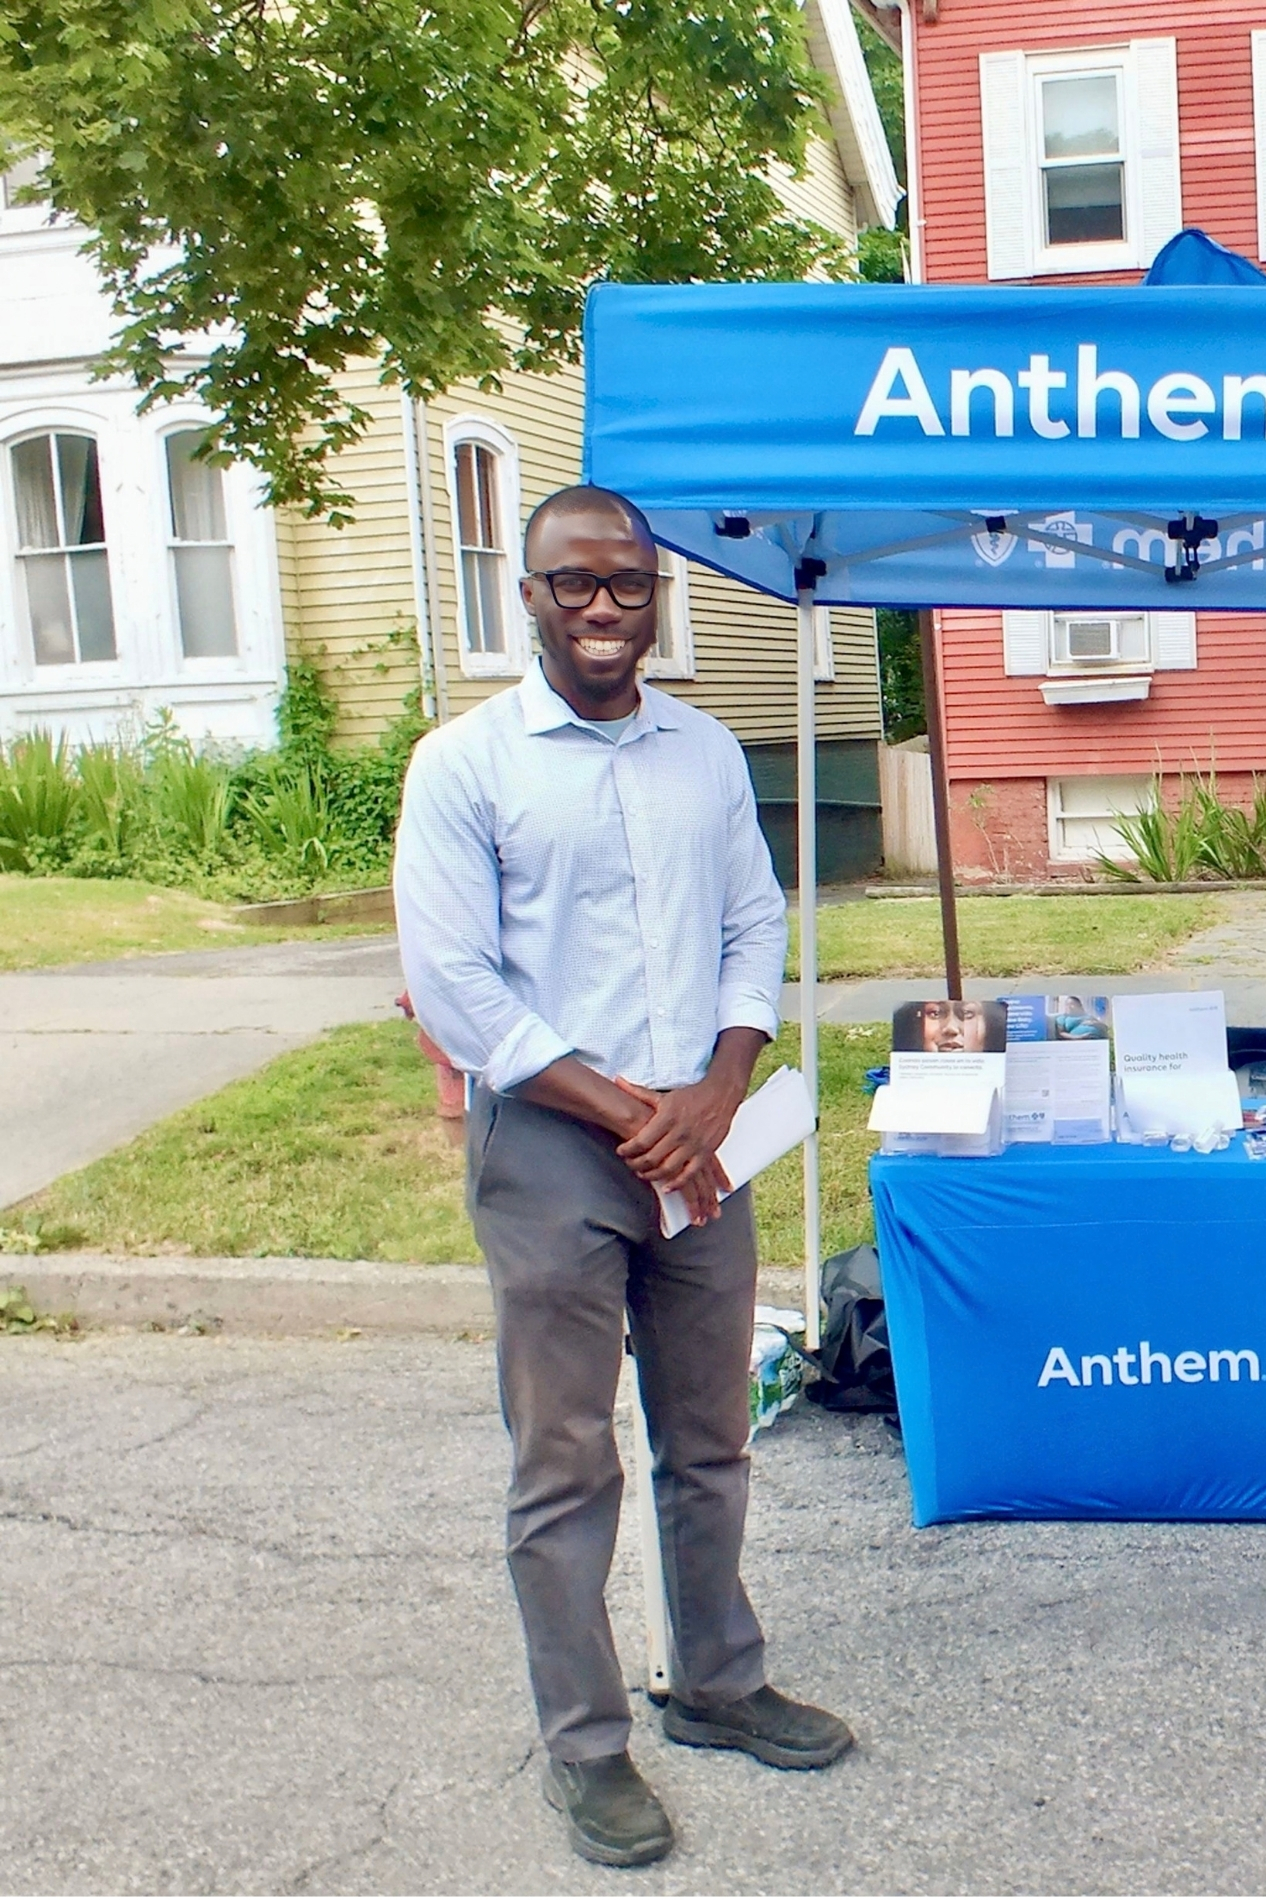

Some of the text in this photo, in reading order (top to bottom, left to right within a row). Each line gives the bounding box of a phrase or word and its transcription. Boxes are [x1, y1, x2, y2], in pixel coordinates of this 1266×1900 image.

[1123, 1052, 1188, 1062] Quality health
[1037, 1341, 1260, 1388] Anthem
